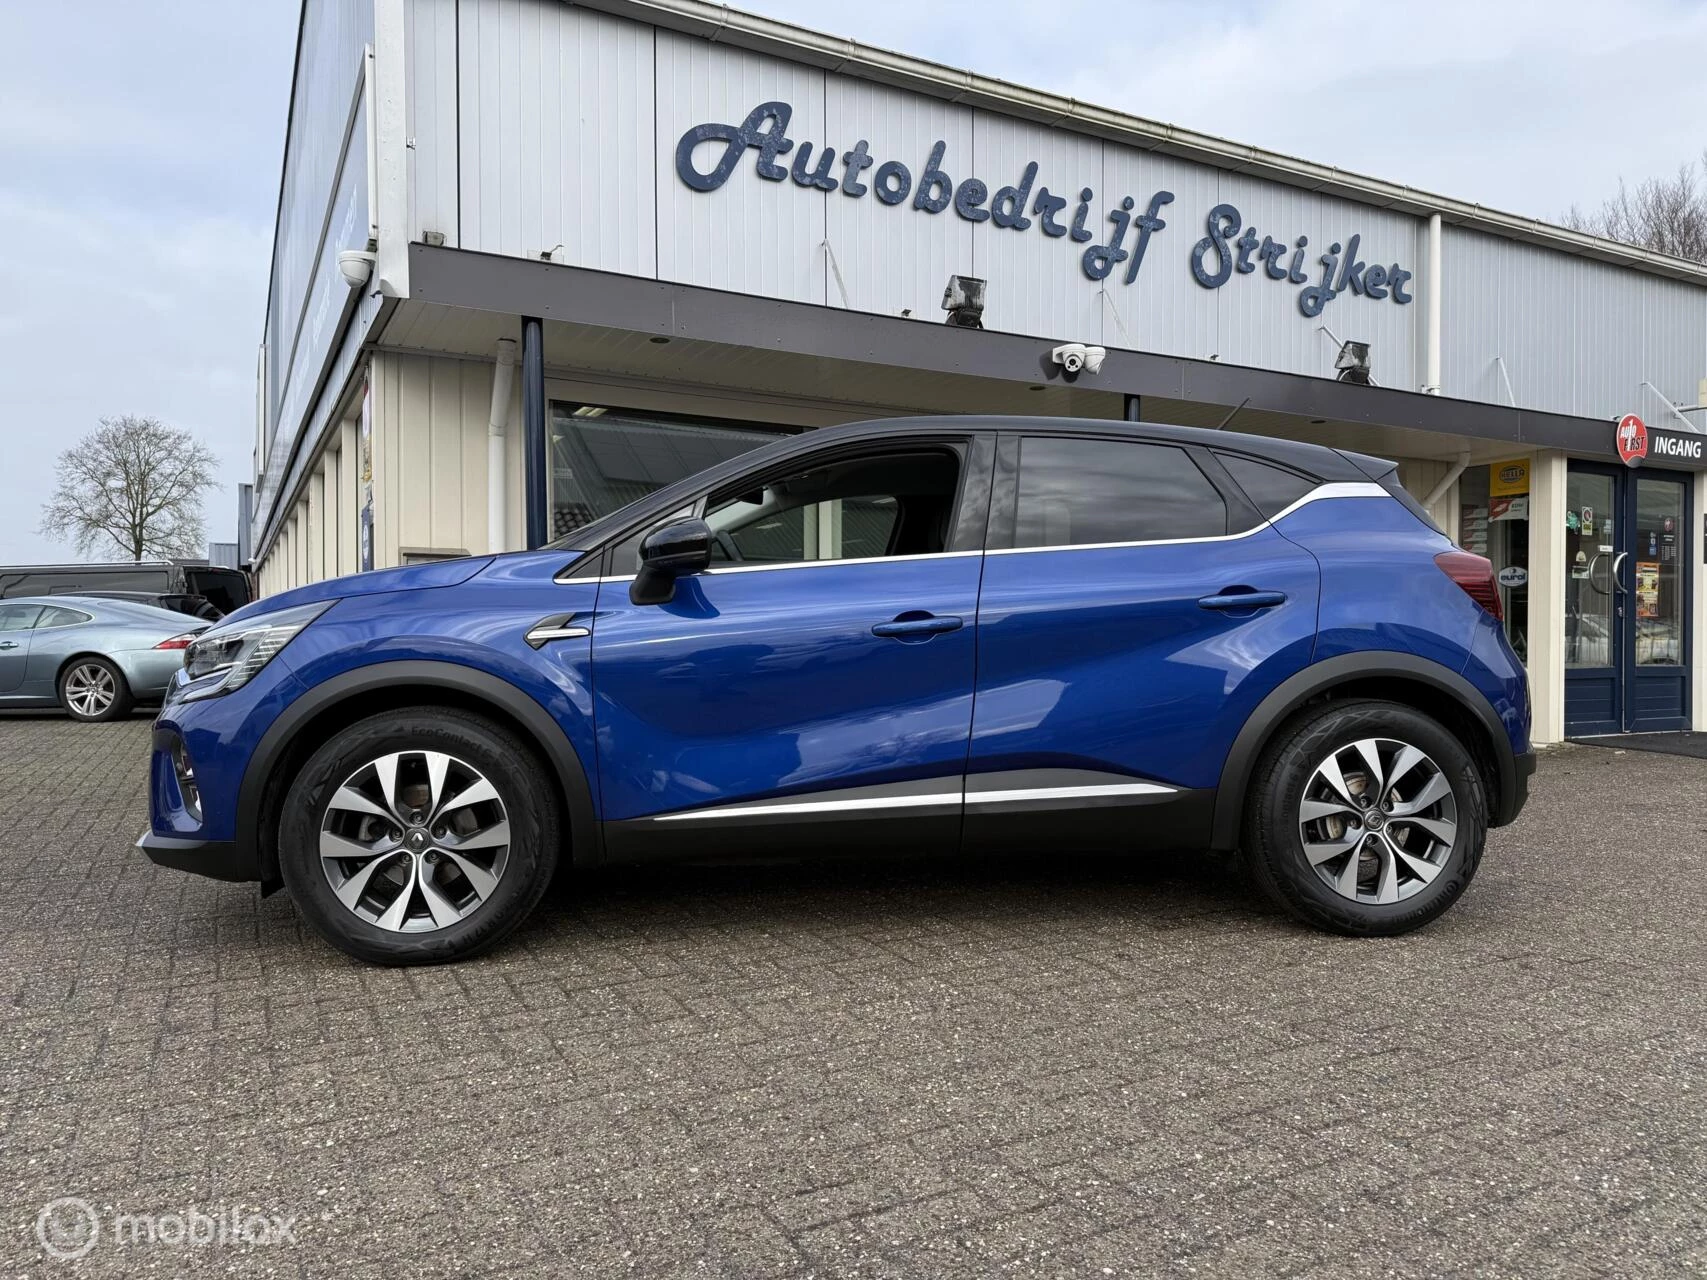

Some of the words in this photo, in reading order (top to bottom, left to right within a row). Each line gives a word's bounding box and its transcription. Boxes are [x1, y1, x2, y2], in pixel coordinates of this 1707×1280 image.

[676, 101, 1175, 285] Autobedrijf
[1191, 203, 1413, 318] Strijker
[1654, 436, 1702, 458] INGANG
